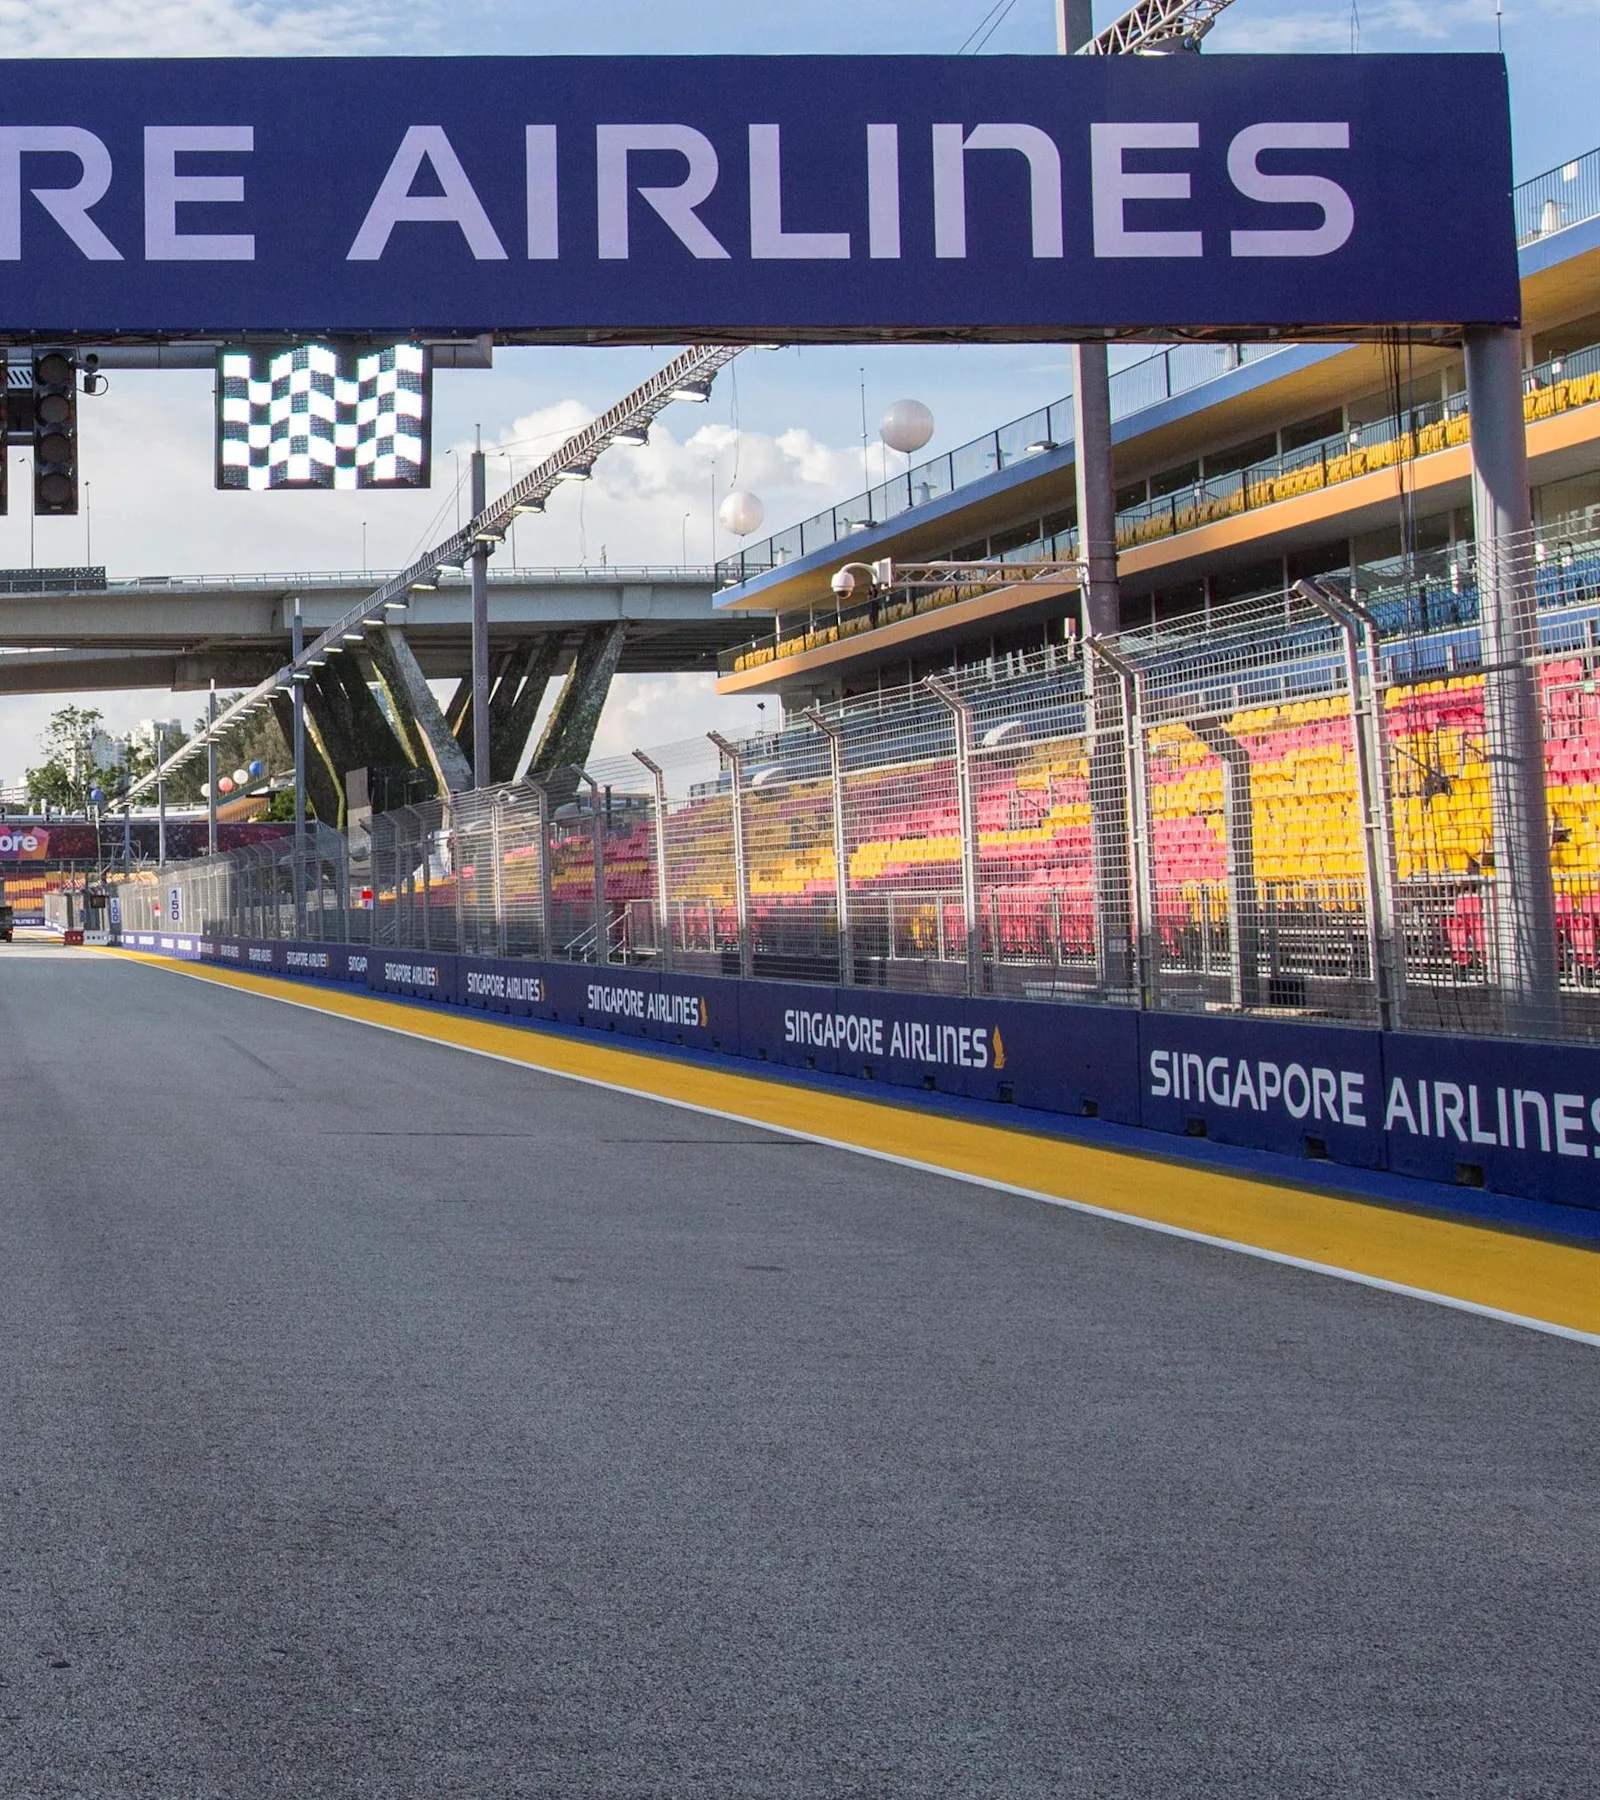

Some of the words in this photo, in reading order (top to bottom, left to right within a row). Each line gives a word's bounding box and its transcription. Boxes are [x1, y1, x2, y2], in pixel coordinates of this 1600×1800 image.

[346, 121, 1355, 263] AIRLINES
[170, 889, 181, 921] 150
[348, 955, 368, 972] SINGAP
[385, 962, 412, 985] SINGAPORE
[412, 965, 435, 987] AIRLINES
[466, 972, 505, 999] SINGAPORE
[505, 976, 540, 1002] AIRLINES
[587, 984, 645, 1019] SINGAPORE
[646, 991, 699, 1027] AIRLINES
[784, 1009, 884, 1057] SINGAPORE
[889, 1021, 988, 1069] AIRLINES
[1150, 1049, 1368, 1128] SINGAPORE
